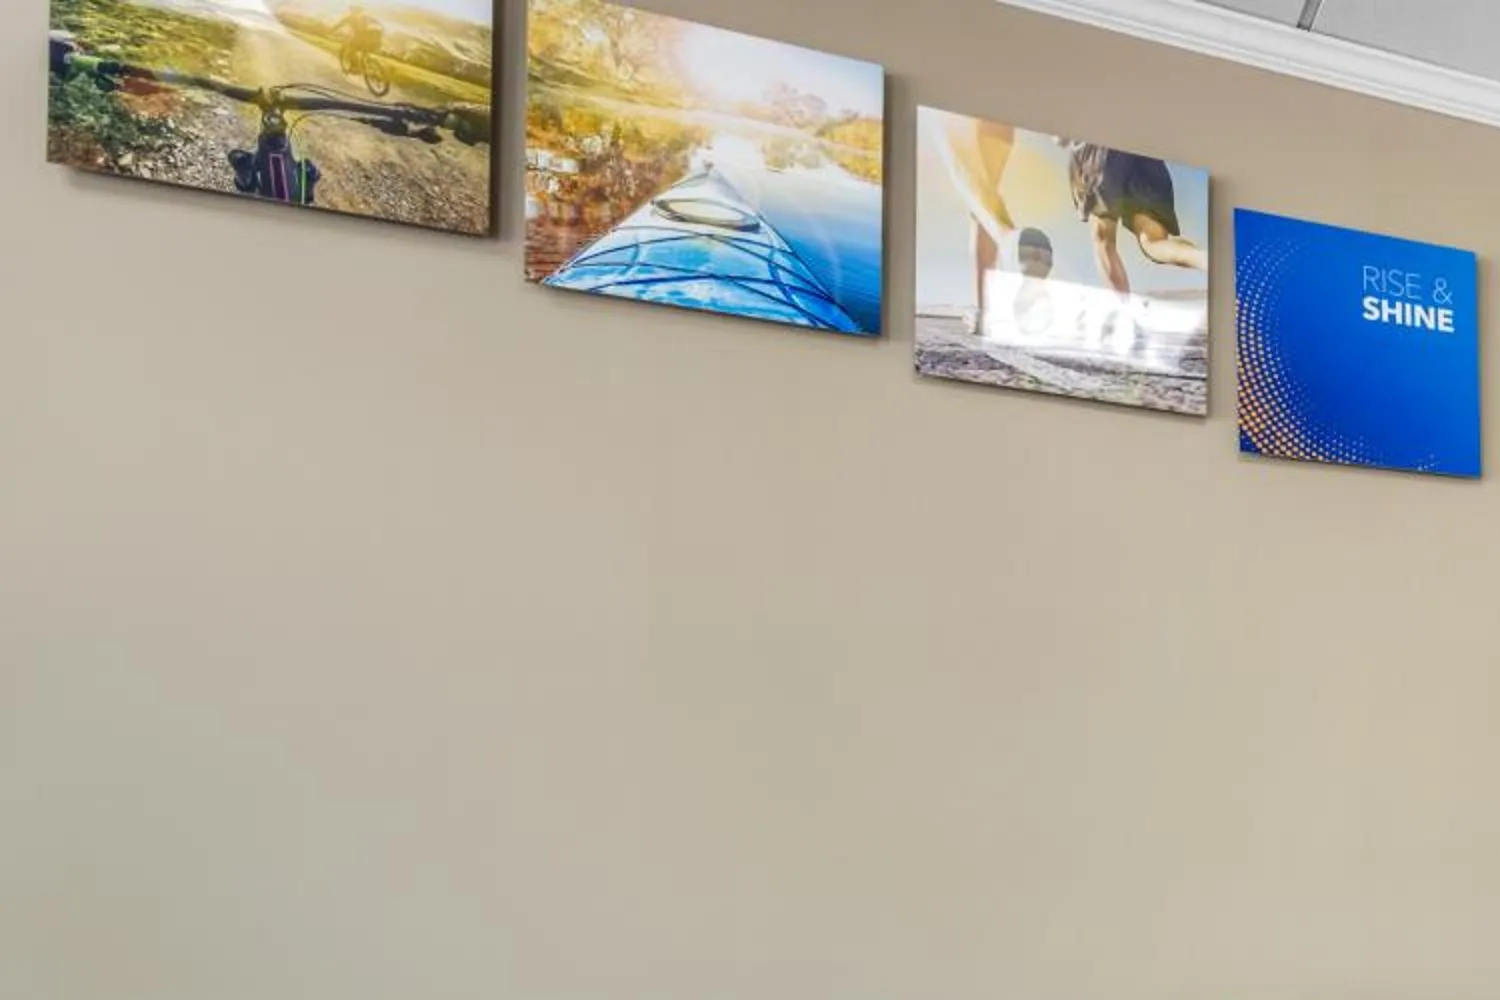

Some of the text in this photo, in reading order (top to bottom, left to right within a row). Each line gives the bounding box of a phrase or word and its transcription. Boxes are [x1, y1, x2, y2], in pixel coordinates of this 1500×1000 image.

[1362, 265, 1453, 304] RISE &
[1362, 296, 1455, 333] SHINE
